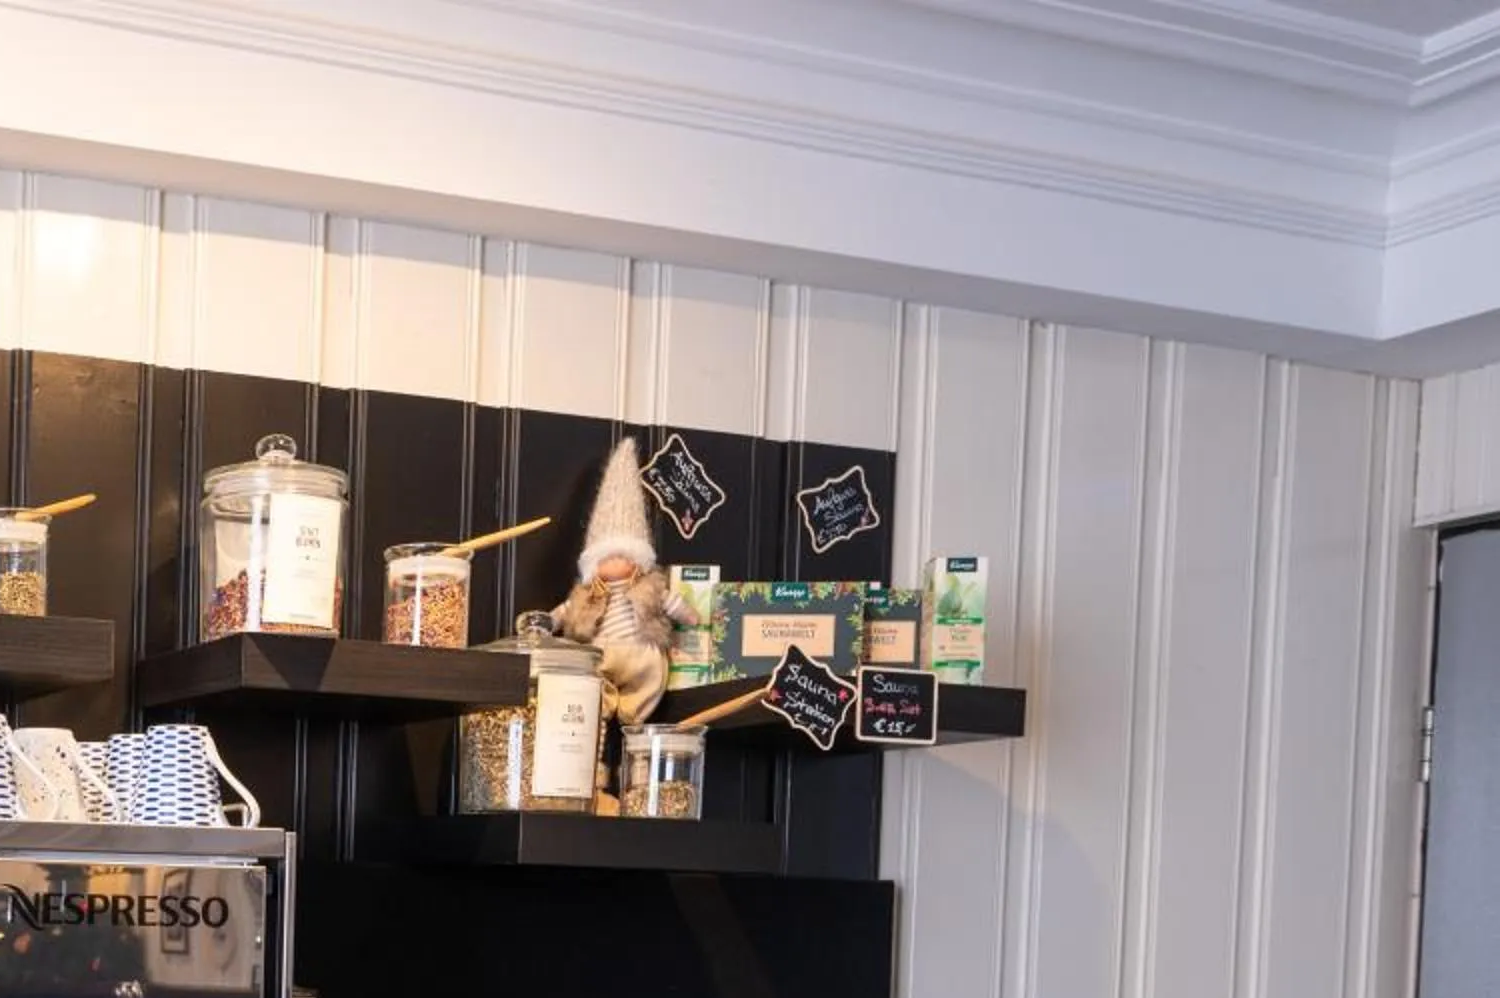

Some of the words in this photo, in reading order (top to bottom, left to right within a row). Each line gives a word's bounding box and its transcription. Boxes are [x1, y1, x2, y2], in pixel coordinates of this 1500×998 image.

[785, 663, 838, 706] Sauna
[872, 673, 920, 697] Sauna
[783, 690, 836, 727] Station
[2, 883, 230, 931] NESPRESSO
